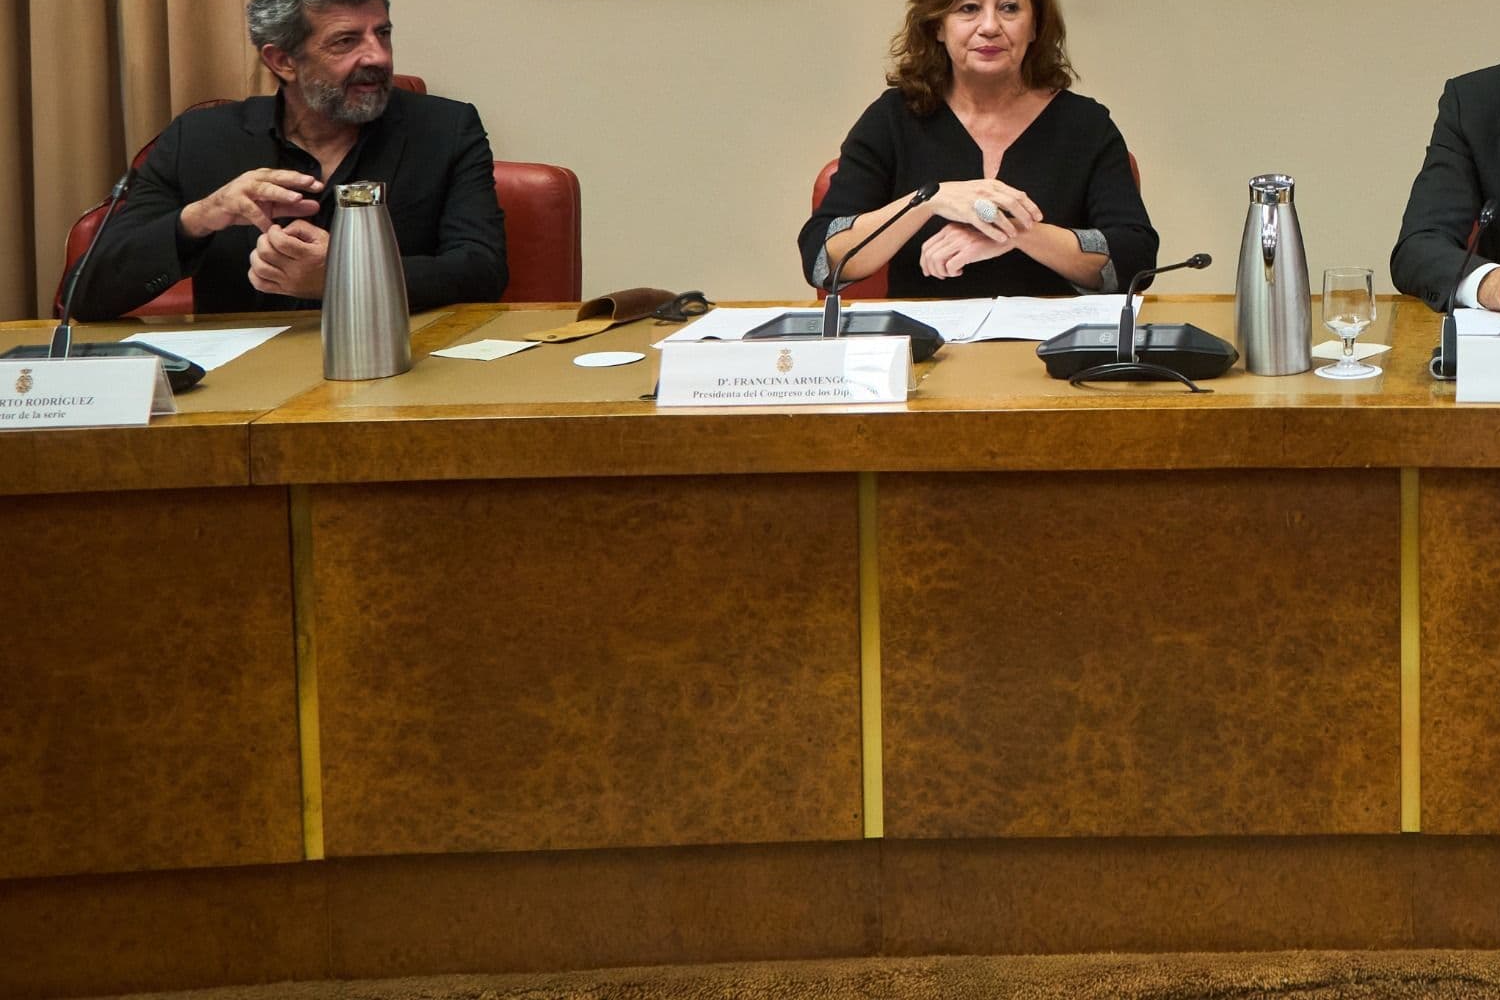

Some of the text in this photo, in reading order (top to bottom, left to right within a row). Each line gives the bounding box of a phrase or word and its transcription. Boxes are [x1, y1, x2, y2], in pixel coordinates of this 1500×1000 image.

[734, 376, 789, 386] FRANCINA
[693, 390, 741, 399] Presidenta
[743, 389, 758, 398] del
[760, 388, 802, 398] Congreso
[805, 388, 816, 396] de
[818, 388, 831, 396] los
[26, 397, 95, 406] RODRÍGUEZ
[19, 411, 29, 419] de
[33, 410, 41, 418] la
[44, 410, 66, 418] serie
